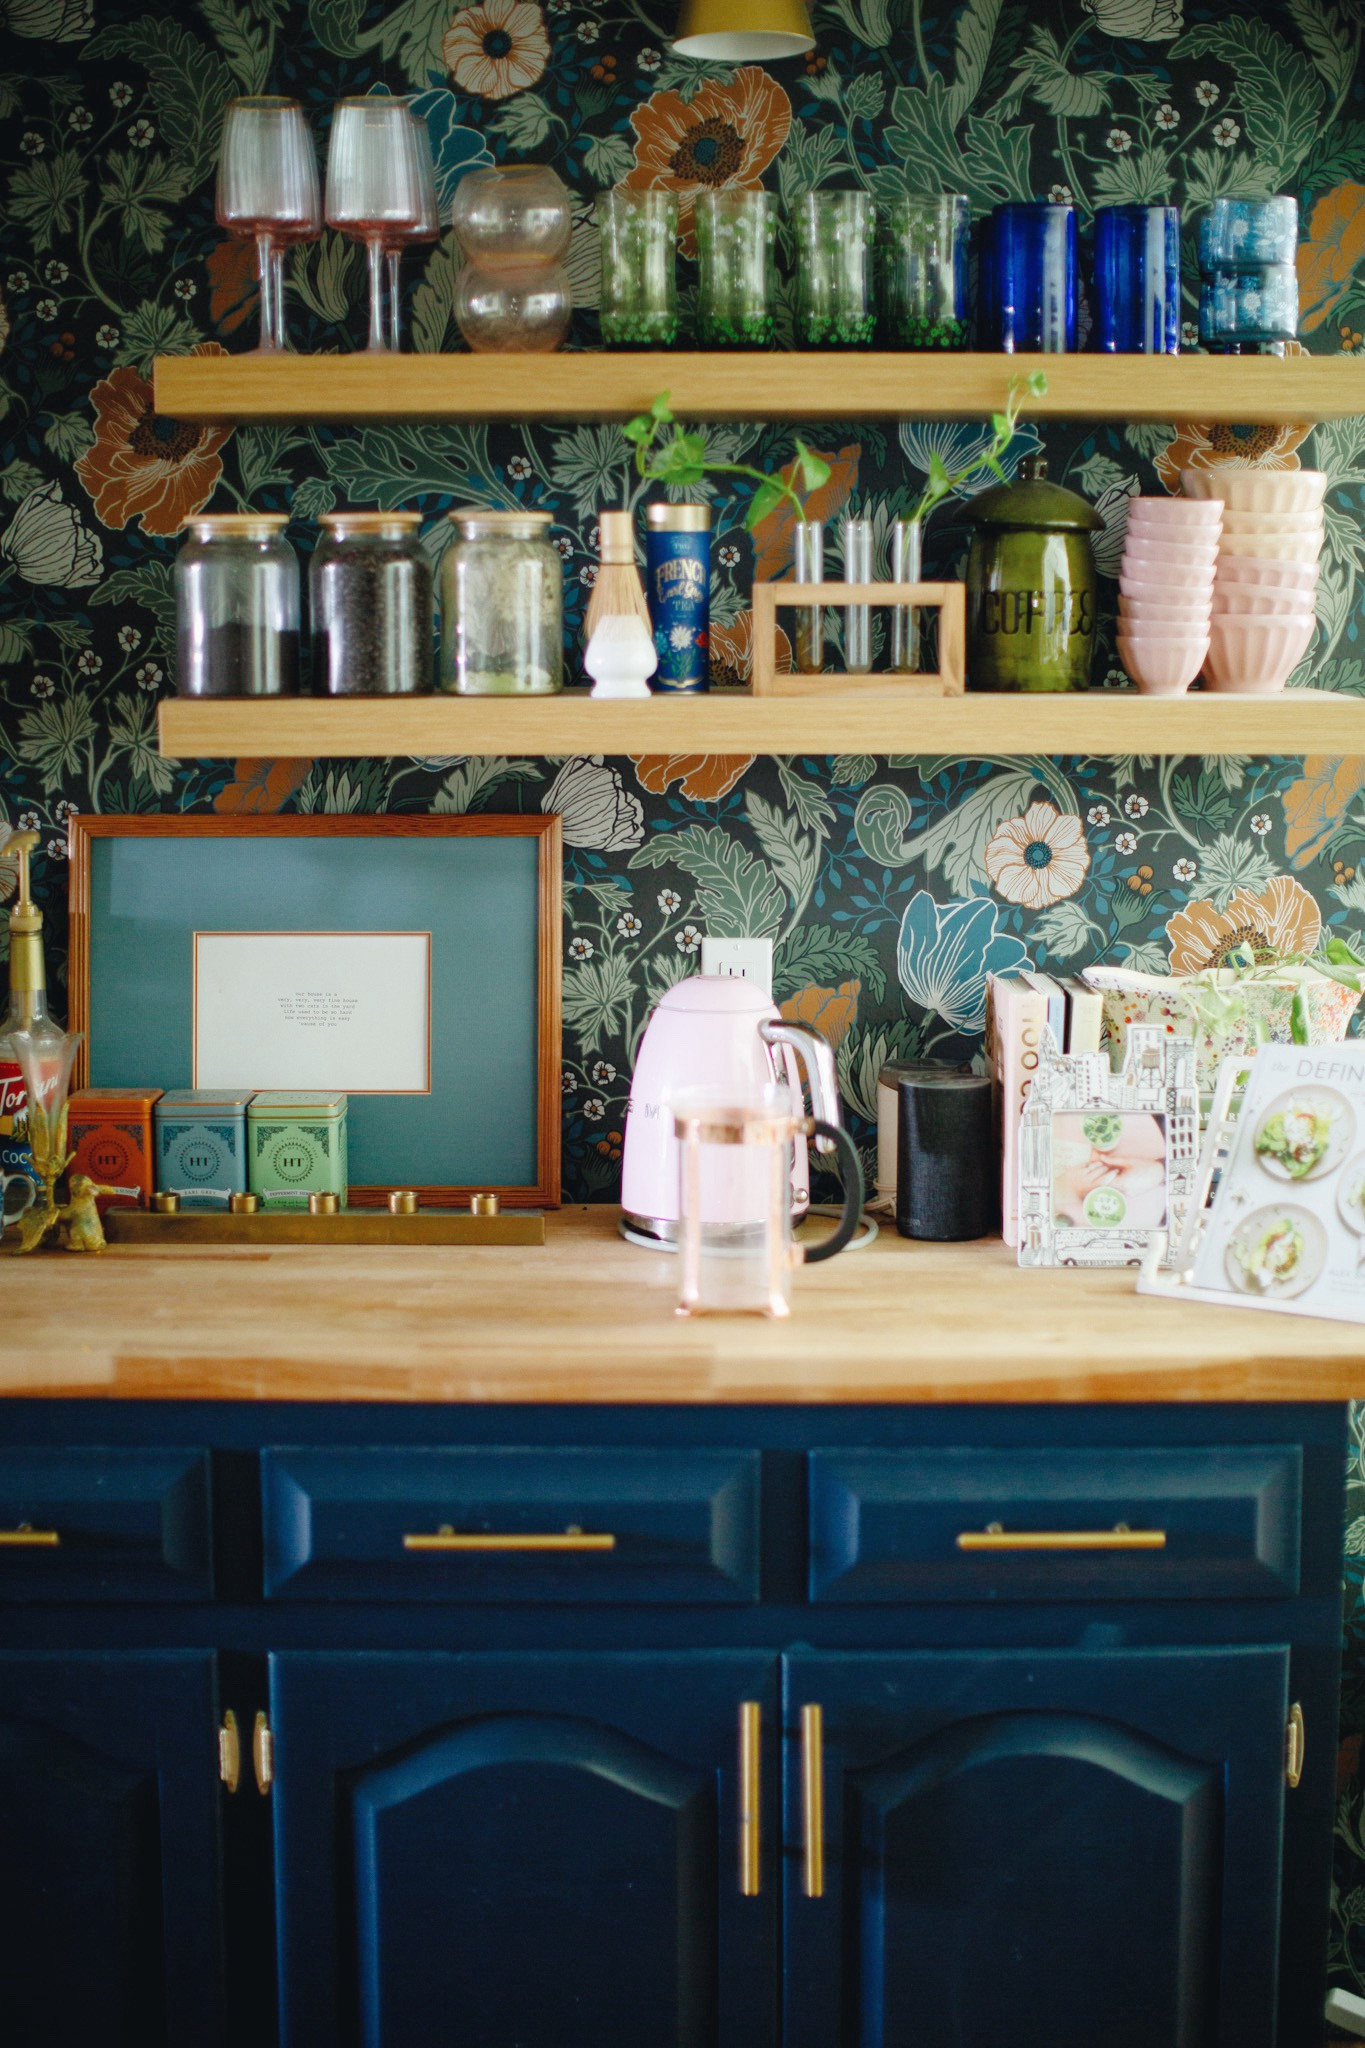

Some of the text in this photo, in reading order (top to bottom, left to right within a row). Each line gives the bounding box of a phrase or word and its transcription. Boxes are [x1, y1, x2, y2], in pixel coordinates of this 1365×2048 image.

[672, 600, 696, 612] TEA
[98, 1155, 120, 1165] HT
[190, 1157, 212, 1167] HT
[283, 1158, 305, 1167] HT
